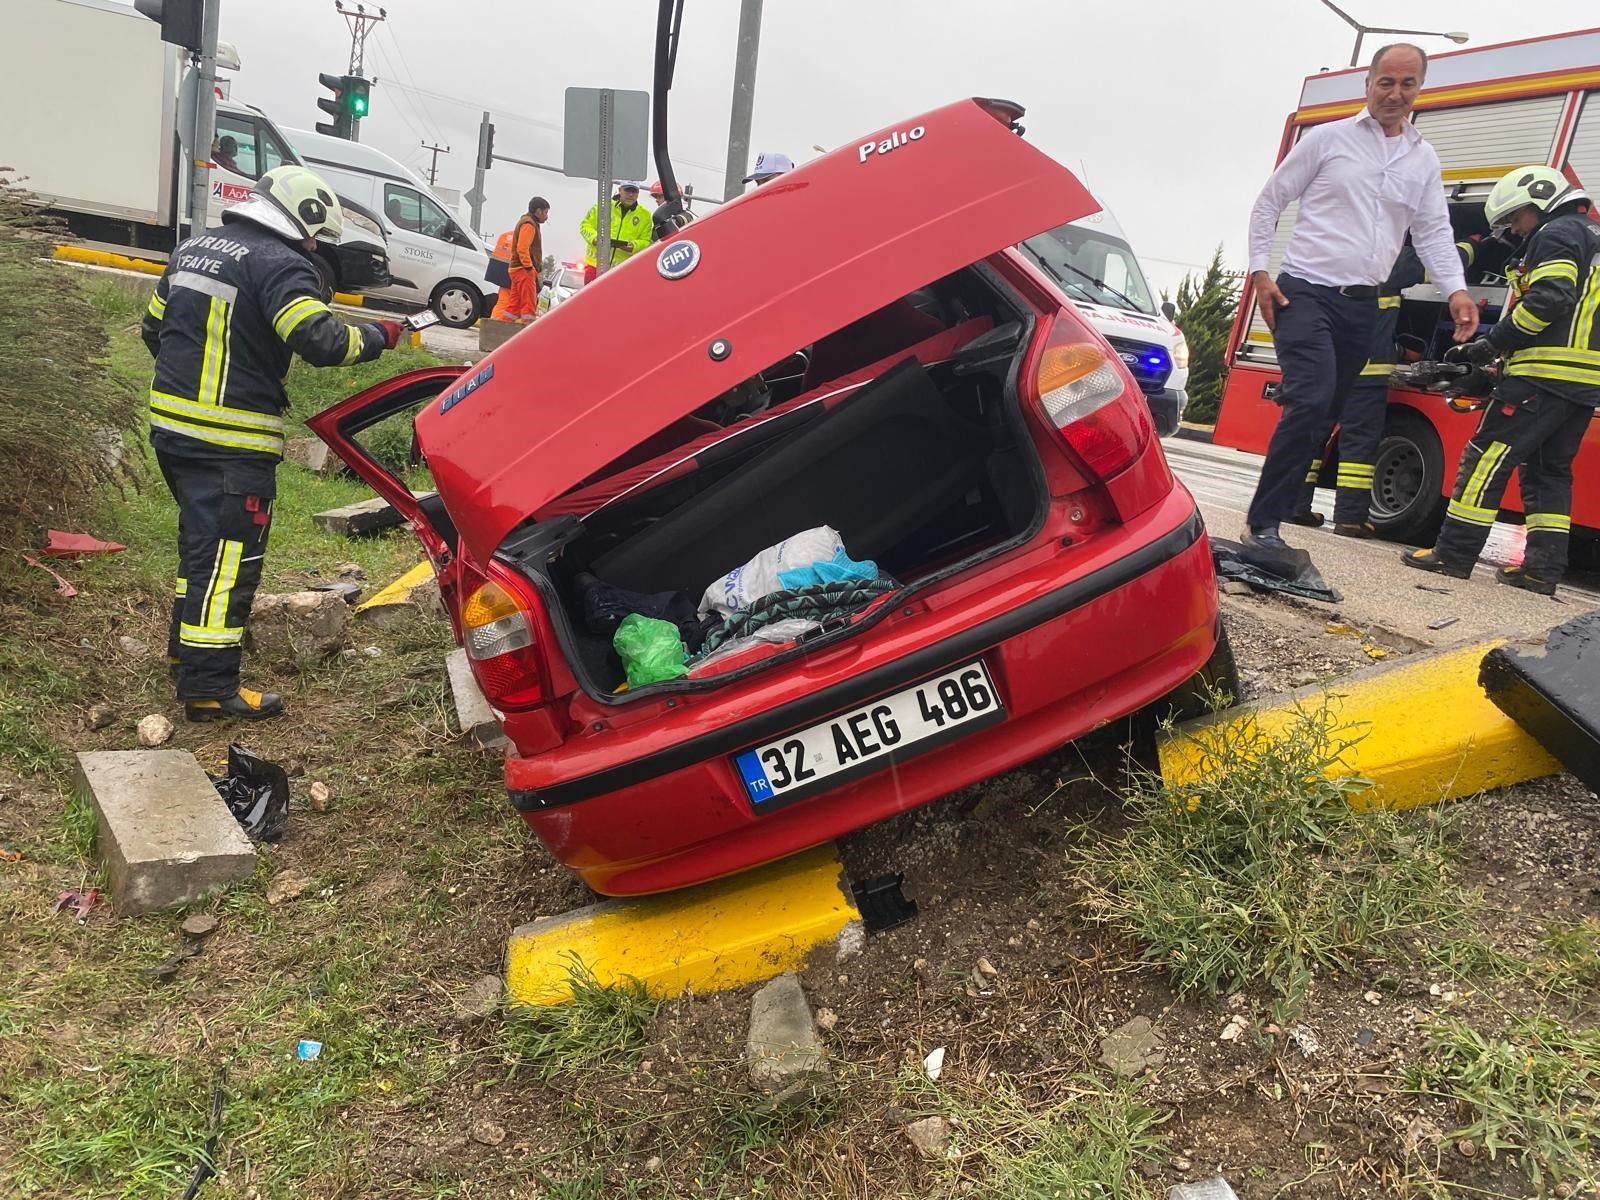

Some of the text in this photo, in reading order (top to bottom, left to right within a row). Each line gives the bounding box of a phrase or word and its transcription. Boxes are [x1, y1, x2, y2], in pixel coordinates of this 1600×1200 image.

[179, 235, 250, 262] BURDUR
[662, 246, 691, 270] FIAT
[762, 669, 992, 789] 32 AEG 486
[750, 780, 768, 793] TR
